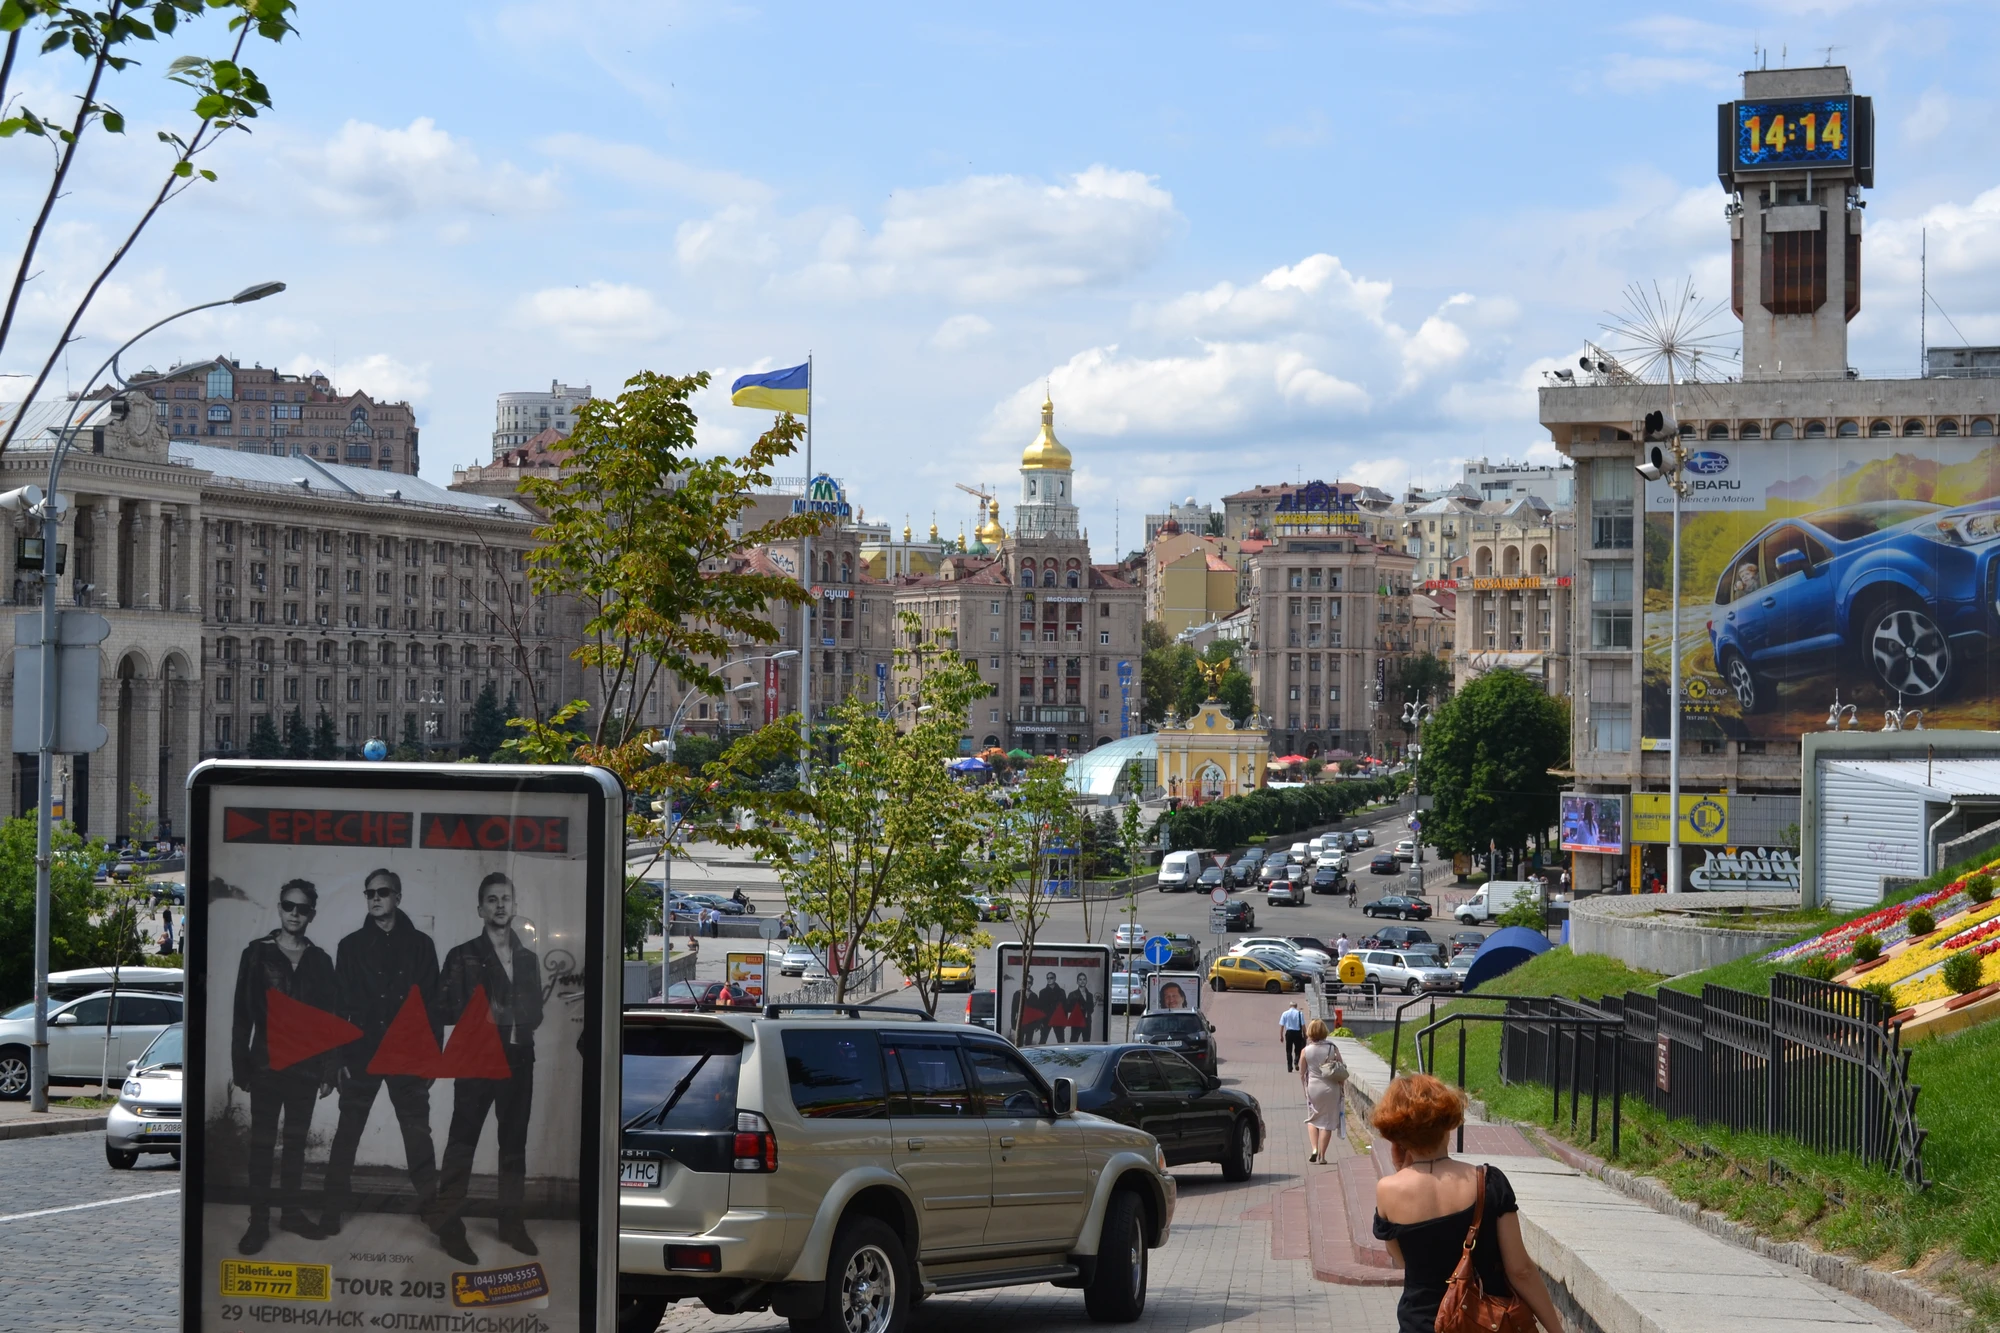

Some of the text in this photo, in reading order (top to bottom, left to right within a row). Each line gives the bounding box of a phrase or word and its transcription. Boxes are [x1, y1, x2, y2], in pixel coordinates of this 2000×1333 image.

[1744, 111, 1844, 153] 14:14
[1691, 480, 1741, 490] BARU
[793, 499, 850, 517] МТРОБУД
[1656, 496, 1710, 504] Condence
[1721, 495, 1755, 503] Motion
[1473, 576, 1541, 590] КОЗАЦЬКИЙ
[635, 1163, 655, 1180] HC
[349, 1252, 414, 1264] ЖИВИЙ ЗВУК
[237, 1264, 293, 1278] biletik.ua
[473, 1267, 537, 1287] (044) 590-5555
[237, 1280, 292, 1294] 28 77 777
[335, 1277, 446, 1299] TOUR 2013
[488, 1278, 541, 1296] karabas.com
[221, 1304, 549, 1333] 29 ЧЕРВНЯ/НСК «ОЛІМПІЙСЬКИЙ»
